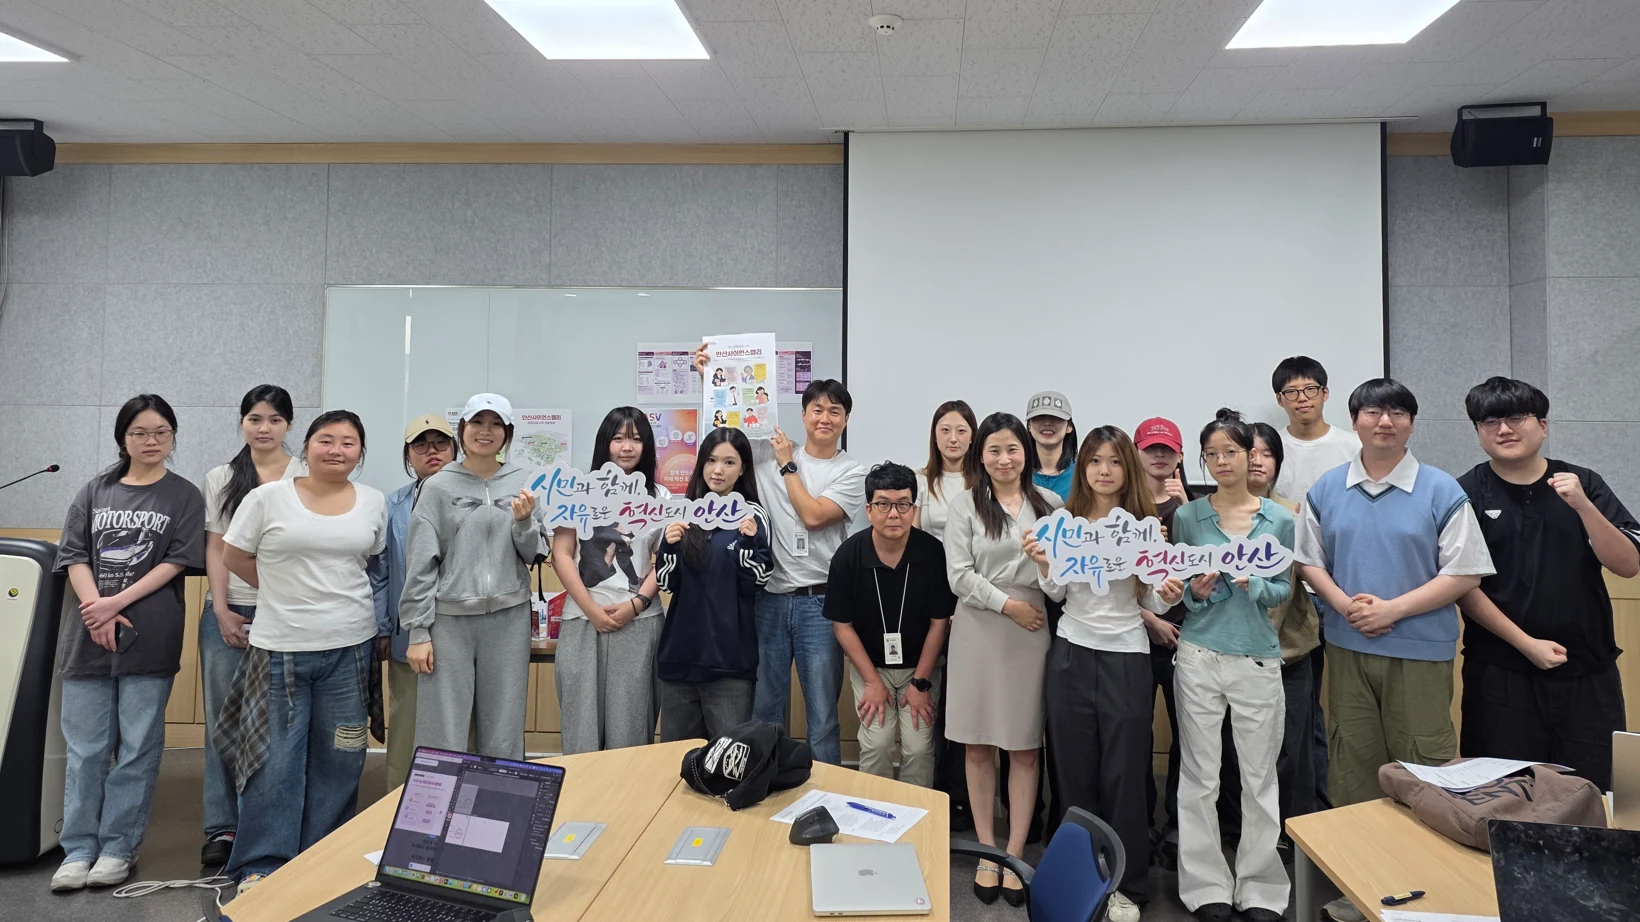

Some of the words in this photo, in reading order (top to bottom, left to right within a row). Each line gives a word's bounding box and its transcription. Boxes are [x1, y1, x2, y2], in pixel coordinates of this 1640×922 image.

[531, 468, 595, 506] 시민과
[91, 510, 171, 534] MOTORSPORT
[551, 503, 612, 533] 자유로운
[619, 501, 687, 531] 혁신도시
[693, 499, 748, 524] 안산
[1036, 516, 1105, 559] 시민과
[1060, 555, 1128, 588] 자유로운
[1136, 550, 1213, 582] 혁신도시
[1221, 542, 1286, 570] 안산
